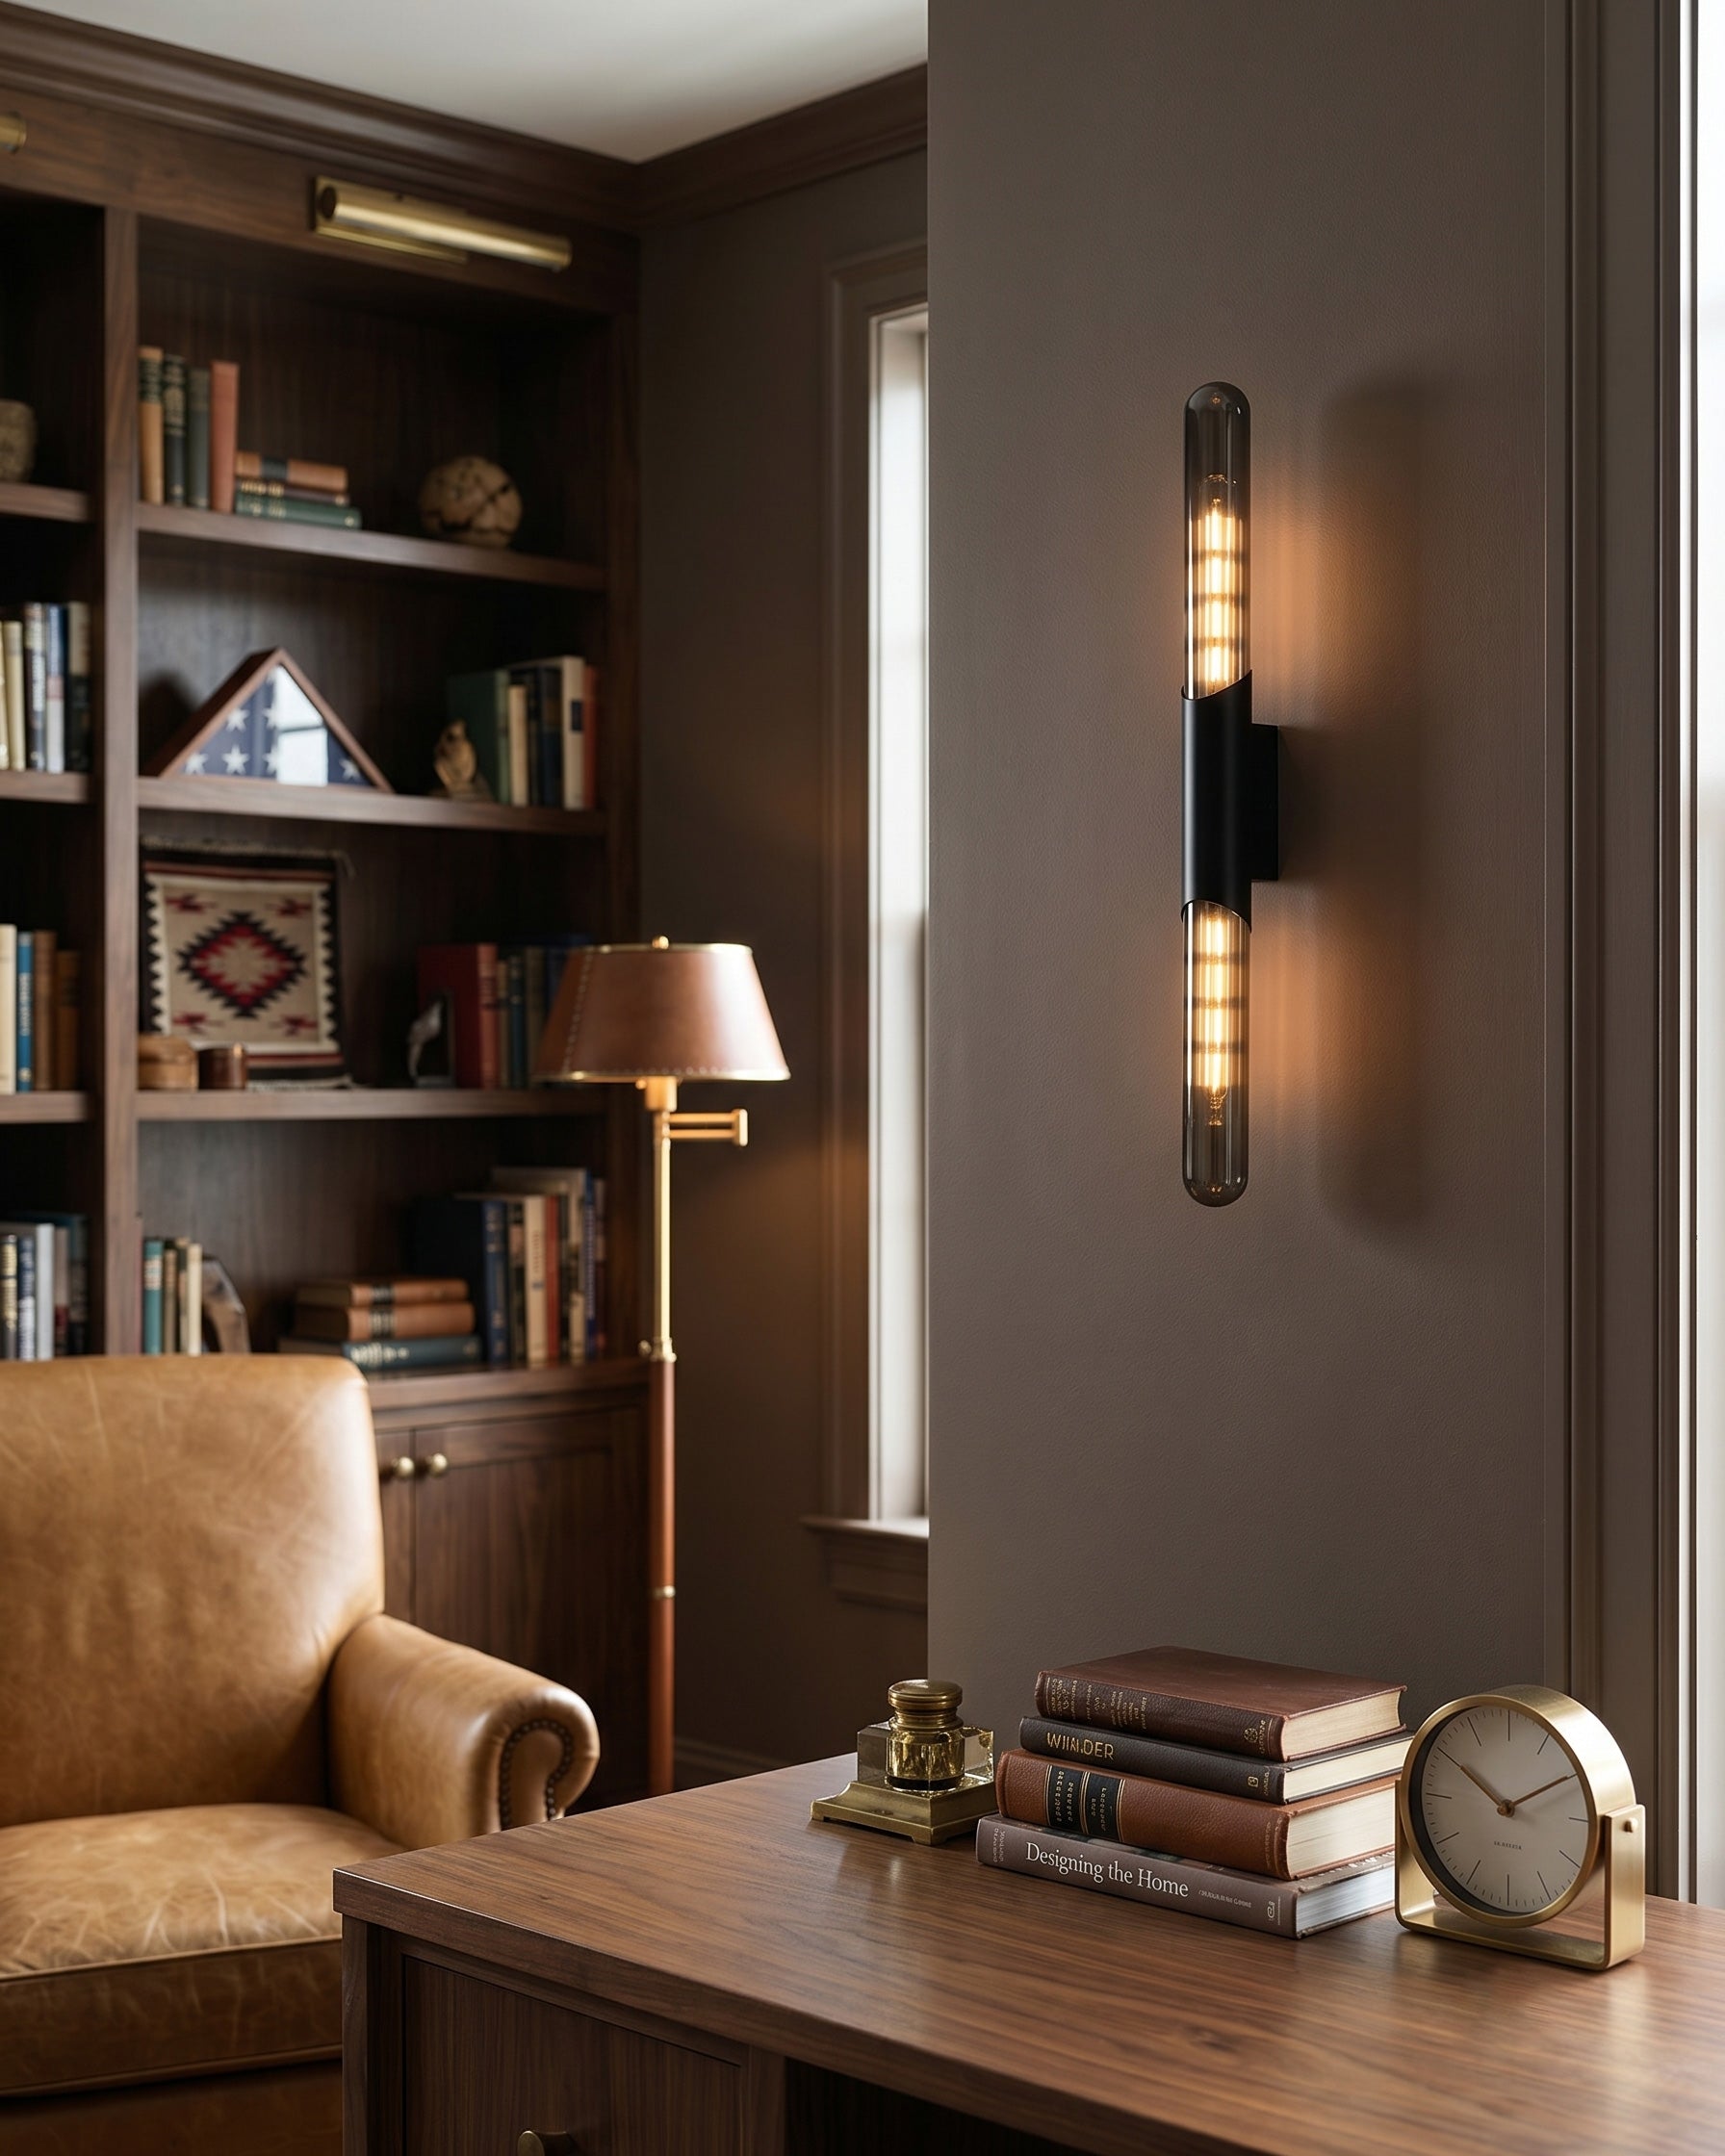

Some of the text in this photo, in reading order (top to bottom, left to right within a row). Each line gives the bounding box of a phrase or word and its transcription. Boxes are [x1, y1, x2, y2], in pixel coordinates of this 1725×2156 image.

[1026, 1842, 1104, 1883] Designing
[1108, 1861, 1133, 1884] the
[1138, 1868, 1189, 1897] Home
